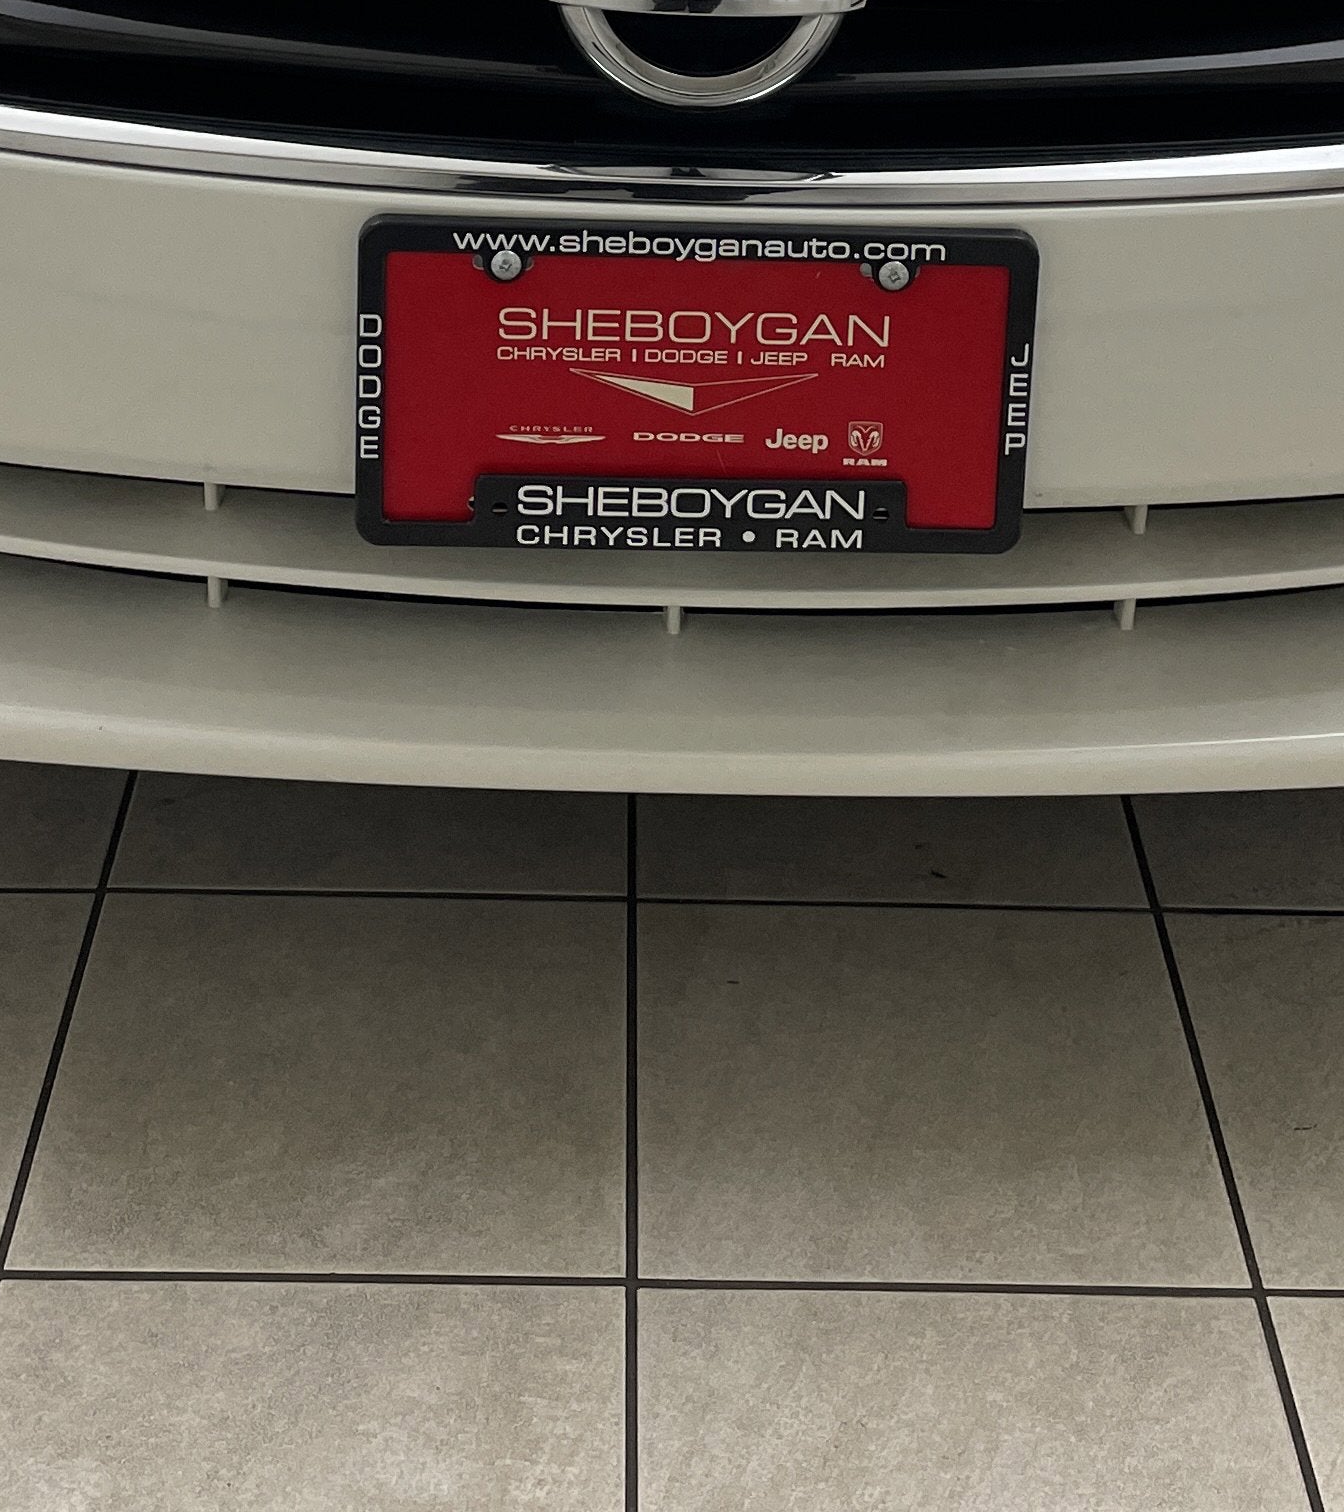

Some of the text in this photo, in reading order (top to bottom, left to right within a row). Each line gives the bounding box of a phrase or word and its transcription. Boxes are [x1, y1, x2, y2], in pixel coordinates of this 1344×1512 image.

[452, 230, 947, 262] www.sheboyganauto.com
[497, 306, 890, 348] SHEBOYGAN
[496, 346, 885, 368] CHRYSLER DODGE JEEP RAM
[357, 313, 382, 461] DODGE
[1004, 343, 1030, 456] JEEP
[509, 424, 593, 433] CHRYSLER
[632, 432, 745, 444] DODGE
[764, 428, 829, 454] Jeep
[842, 458, 888, 467] RAM
[516, 484, 866, 520] SHEBOYGAN
[515, 525, 863, 550] CHRYSLER RAM
